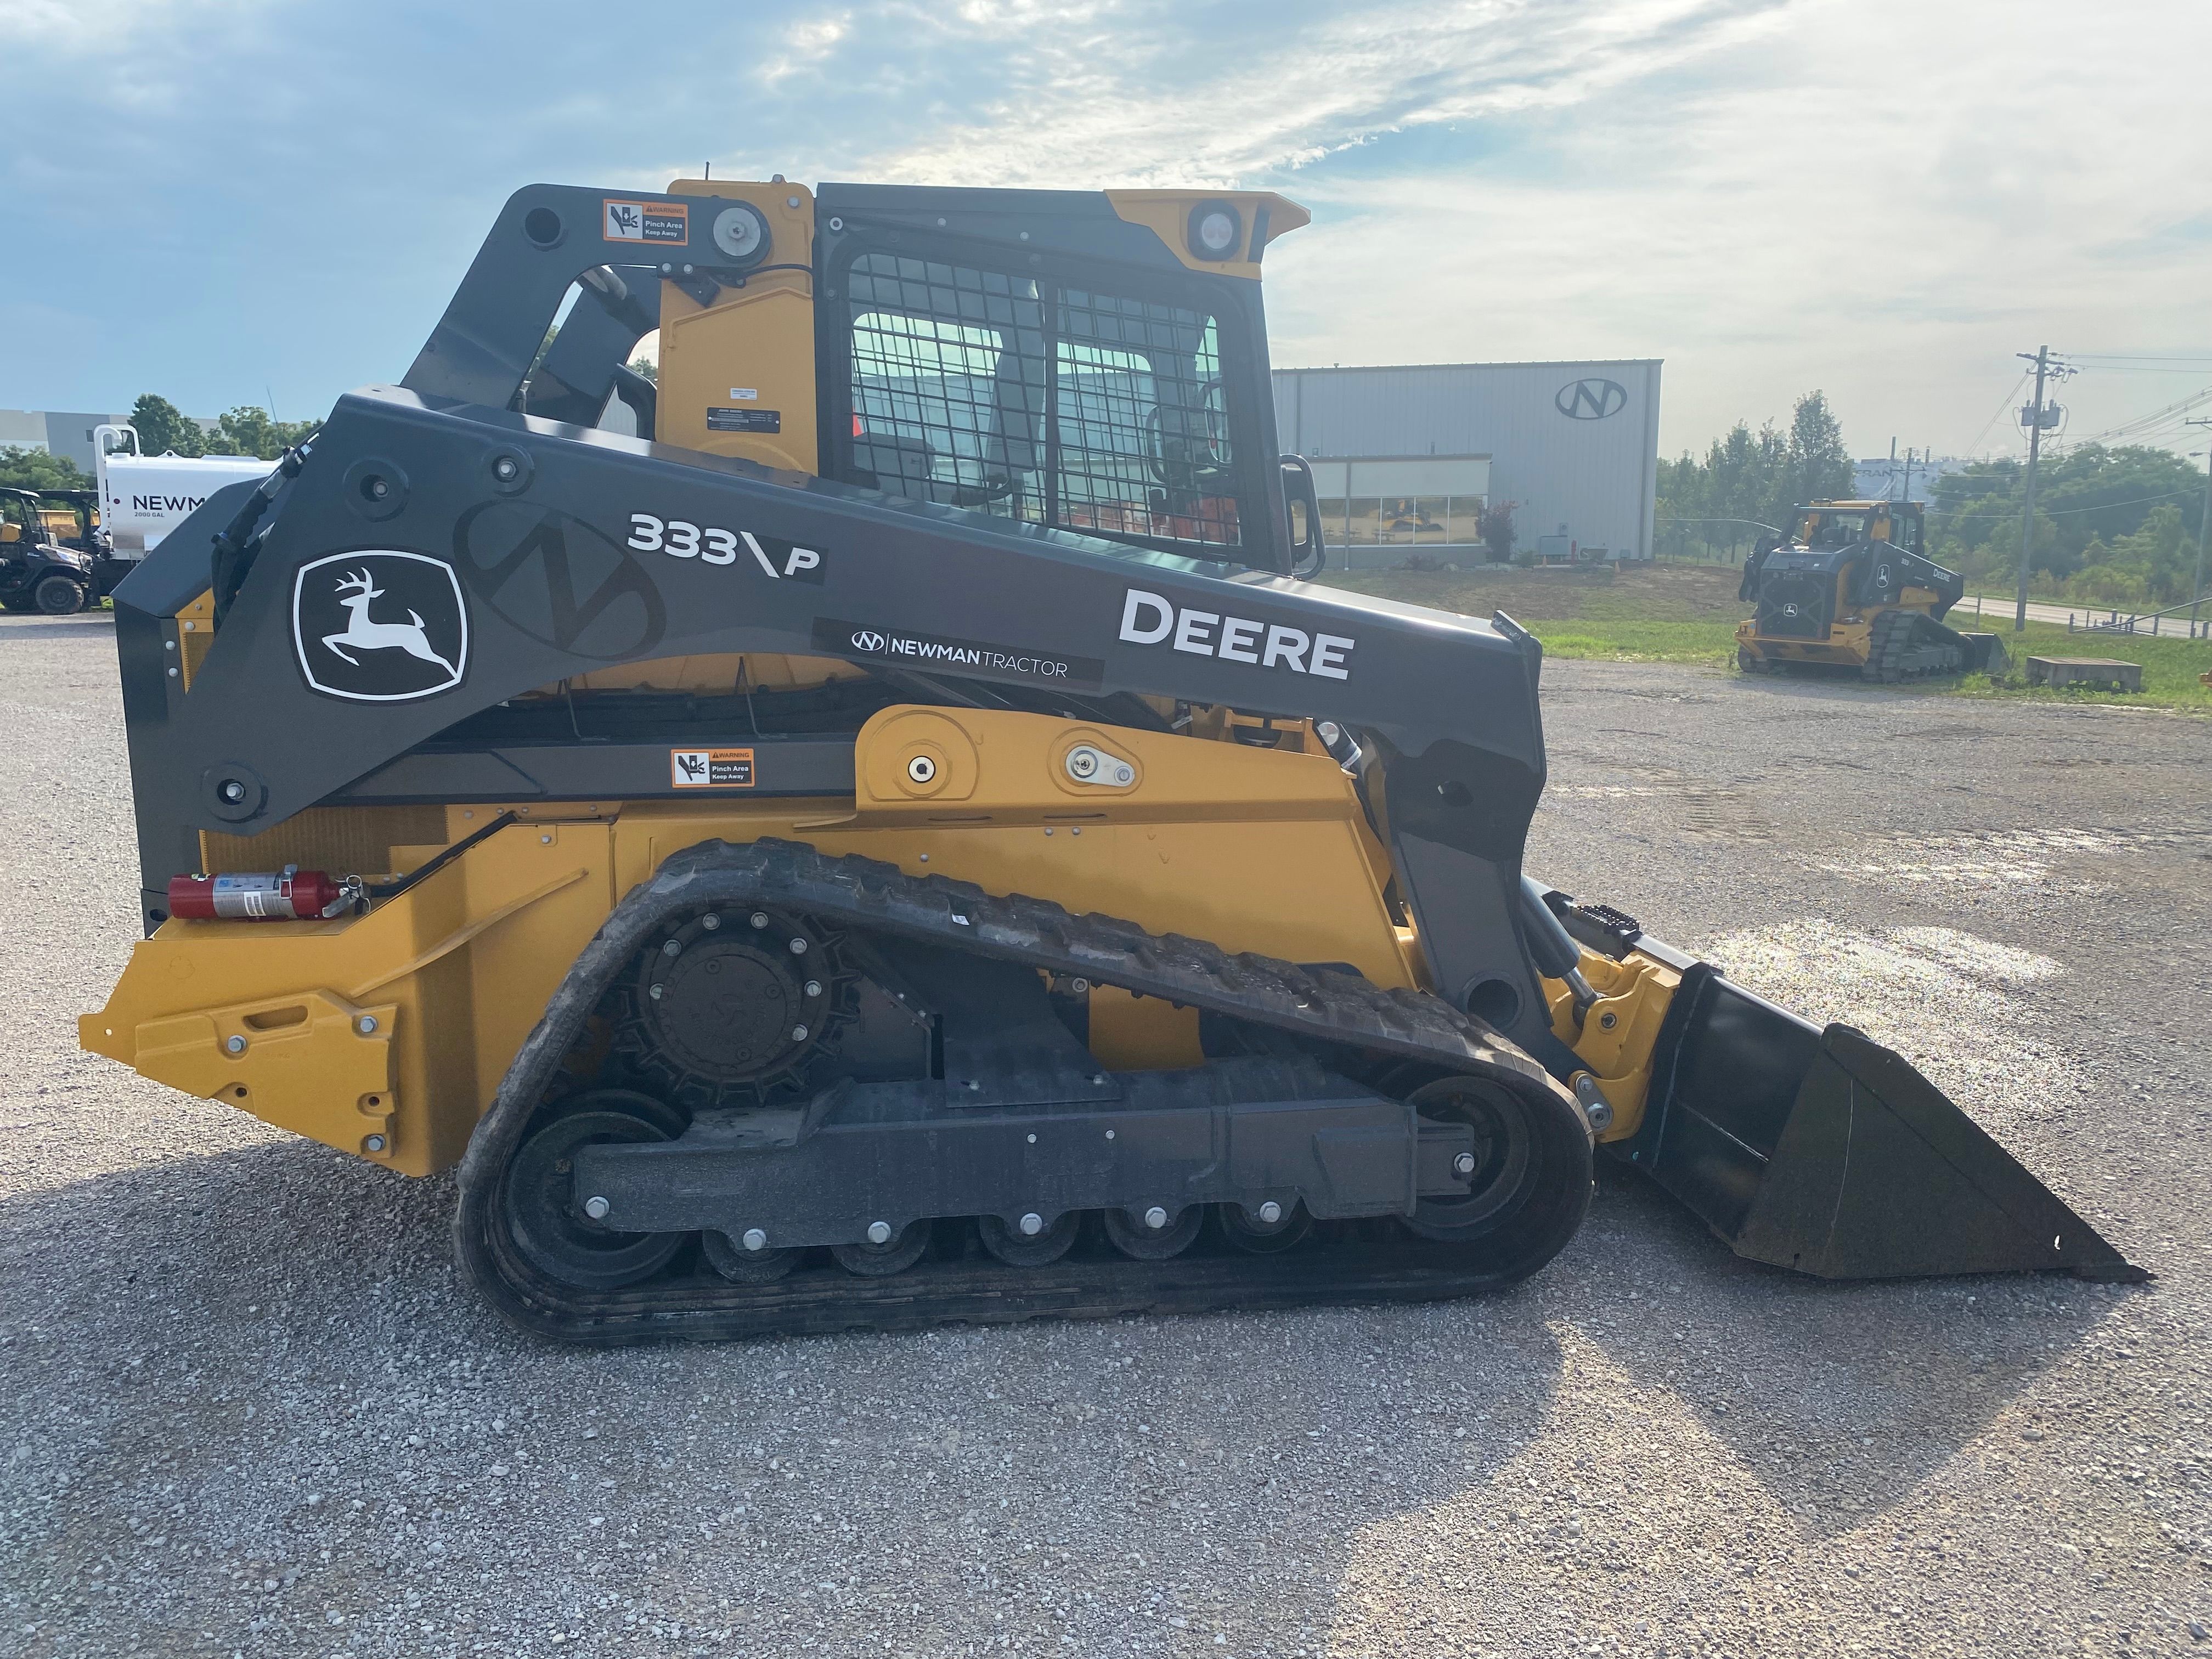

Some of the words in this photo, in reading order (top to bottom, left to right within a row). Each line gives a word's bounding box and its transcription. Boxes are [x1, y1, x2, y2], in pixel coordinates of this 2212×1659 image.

[645, 220, 664, 228] Pinch
[666, 221, 683, 229] Area
[1933, 568, 1951, 582] DEERE
[1119, 588, 1356, 680] DEERE
